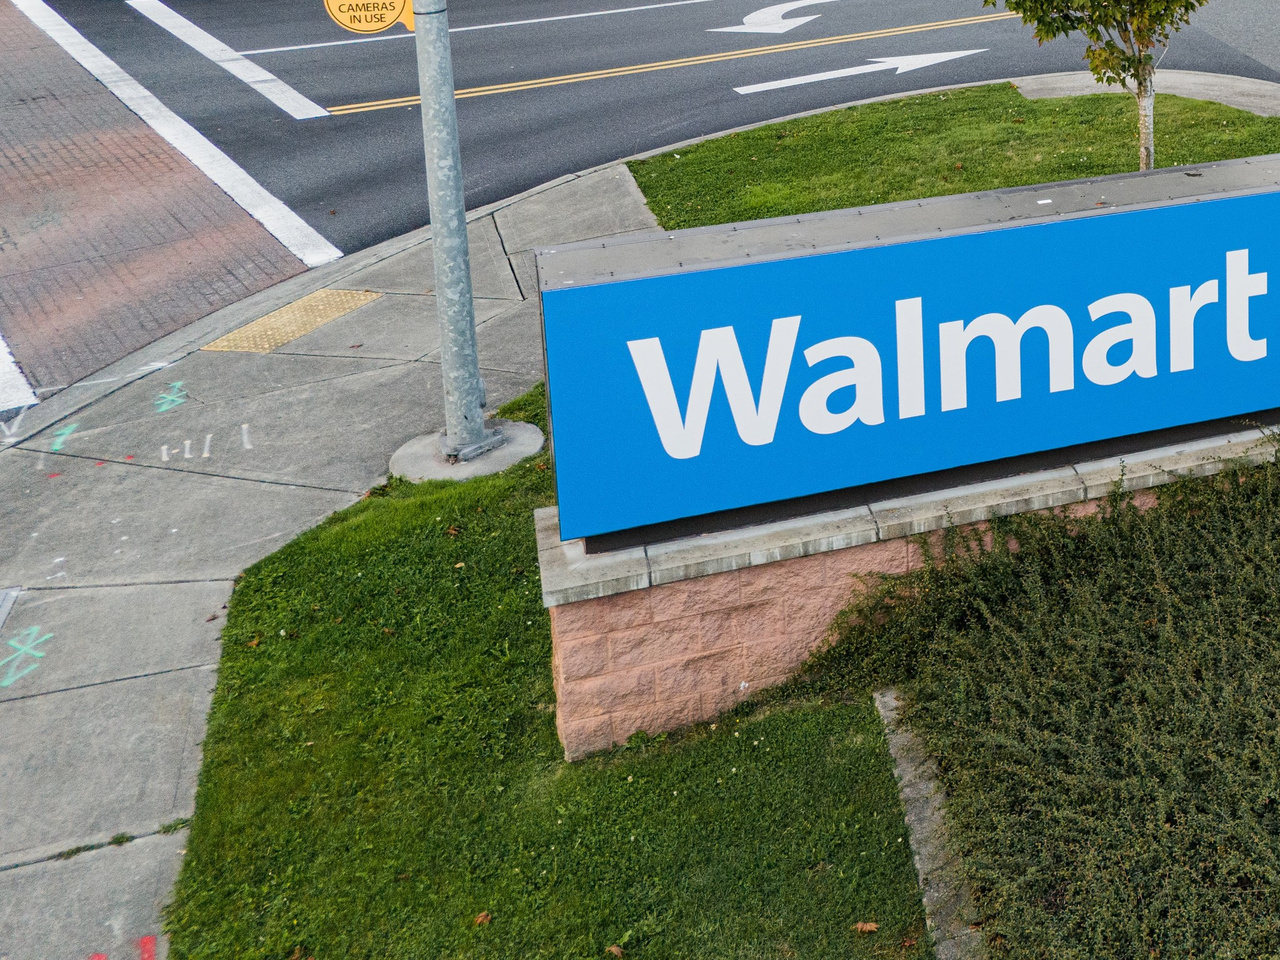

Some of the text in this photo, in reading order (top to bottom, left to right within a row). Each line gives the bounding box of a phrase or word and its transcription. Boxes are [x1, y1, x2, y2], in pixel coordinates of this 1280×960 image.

[338, 1, 396, 14] CAMERAS
[350, 13, 387, 24] IN USE
[627, 249, 1267, 459] Walmart
